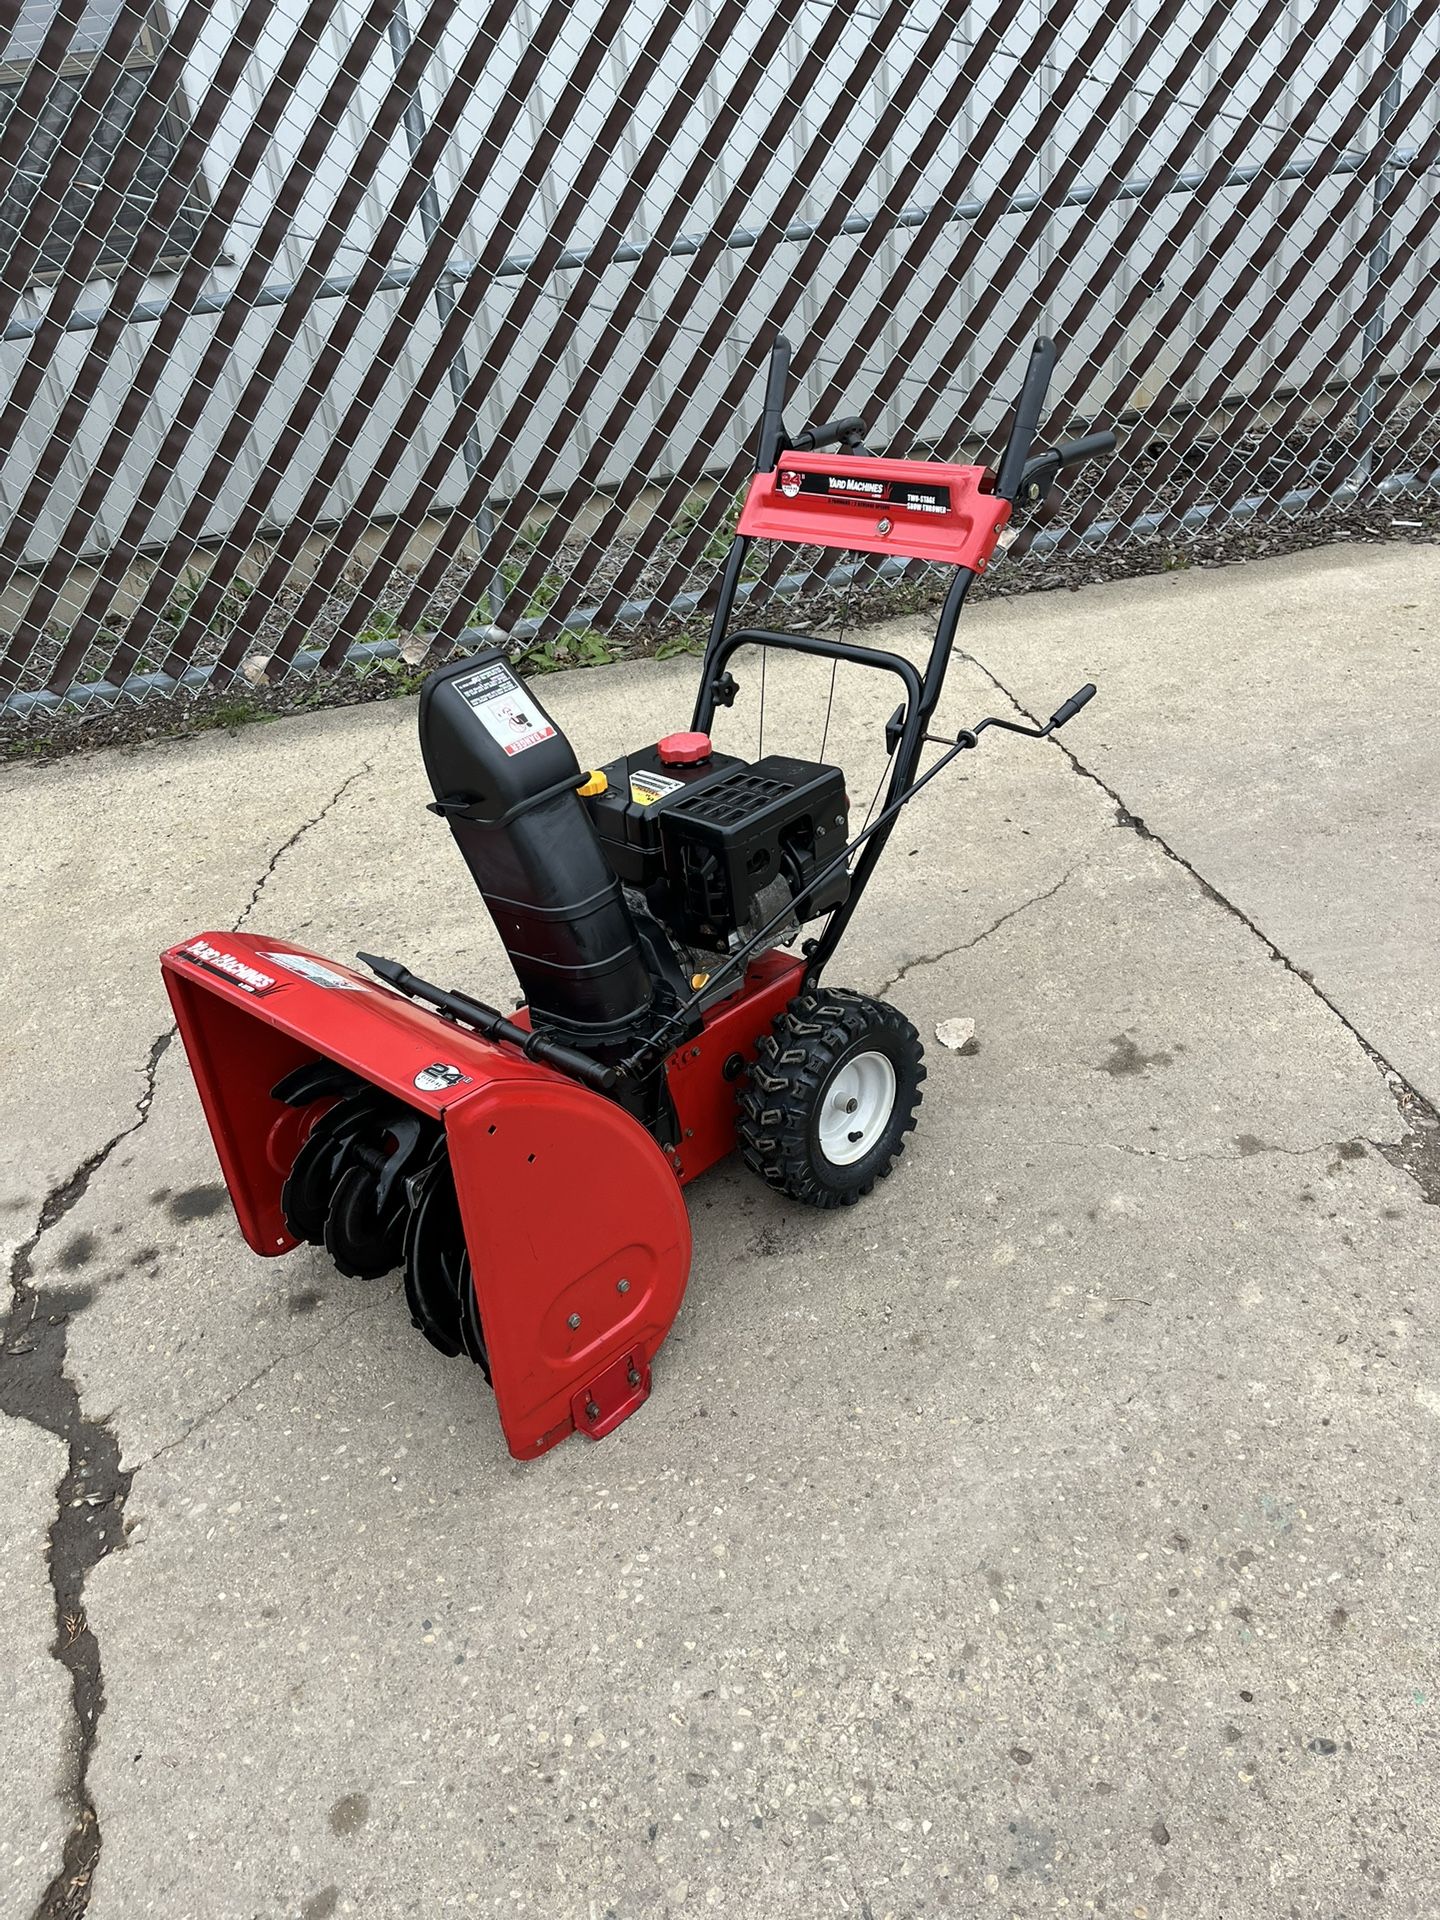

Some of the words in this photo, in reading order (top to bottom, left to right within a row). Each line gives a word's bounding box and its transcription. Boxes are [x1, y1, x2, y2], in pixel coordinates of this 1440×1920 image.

[828, 477, 846, 489] YARD
[846, 479, 883, 493] MACHINES
[907, 493, 936, 504] TWO-STAGE
[510, 733, 541, 751] DANGER
[215, 953, 275, 988] MACHINES
